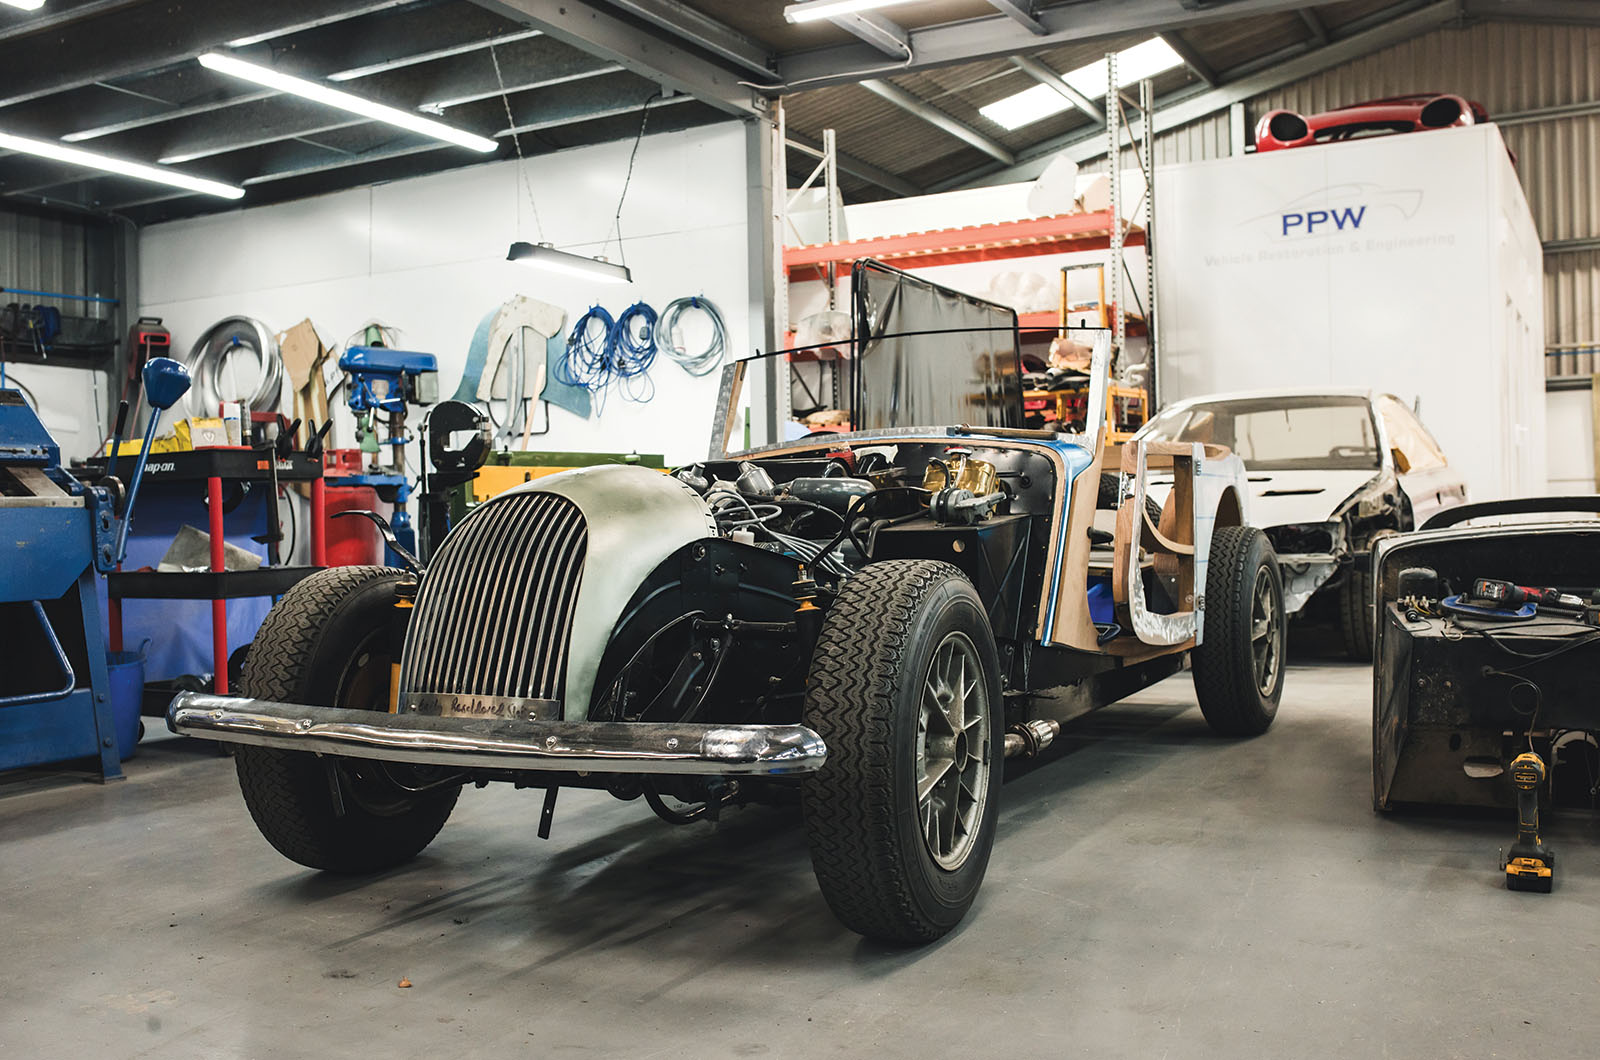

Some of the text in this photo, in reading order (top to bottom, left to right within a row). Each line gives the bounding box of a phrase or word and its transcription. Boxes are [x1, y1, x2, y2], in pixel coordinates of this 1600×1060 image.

[1282, 205, 1367, 236] PPW
[1203, 232, 1456, 267] Vehicle Restoration & Engineering
